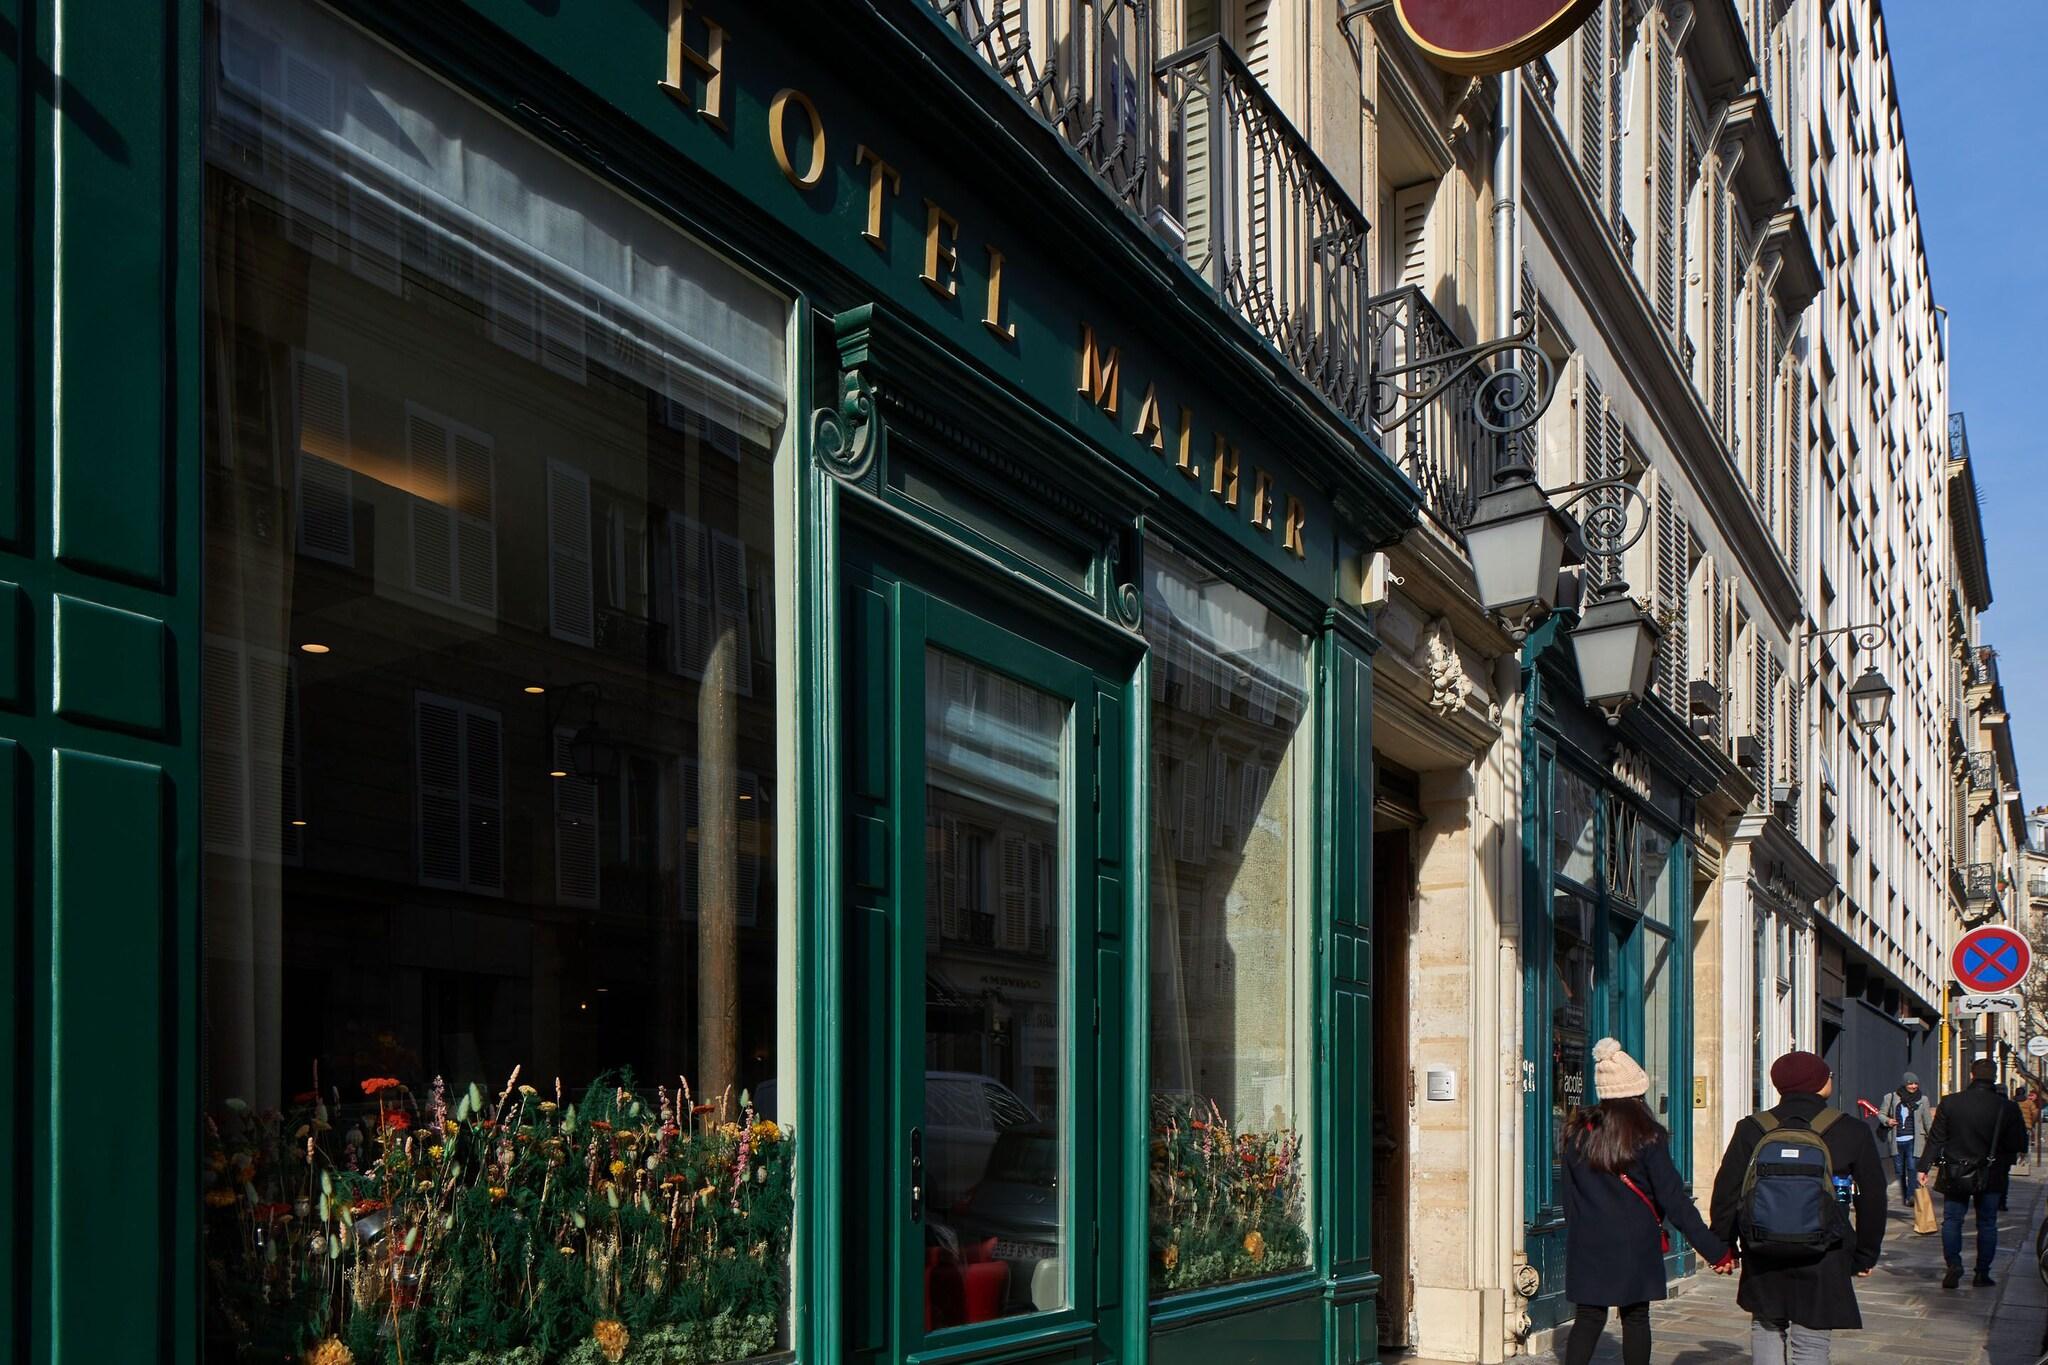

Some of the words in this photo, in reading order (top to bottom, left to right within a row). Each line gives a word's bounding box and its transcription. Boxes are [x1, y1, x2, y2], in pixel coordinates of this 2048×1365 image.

[657, 0, 1016, 342] HOTEL
[1077, 320, 1306, 560] MALHER
[1564, 1071, 1583, 1094] acoté
